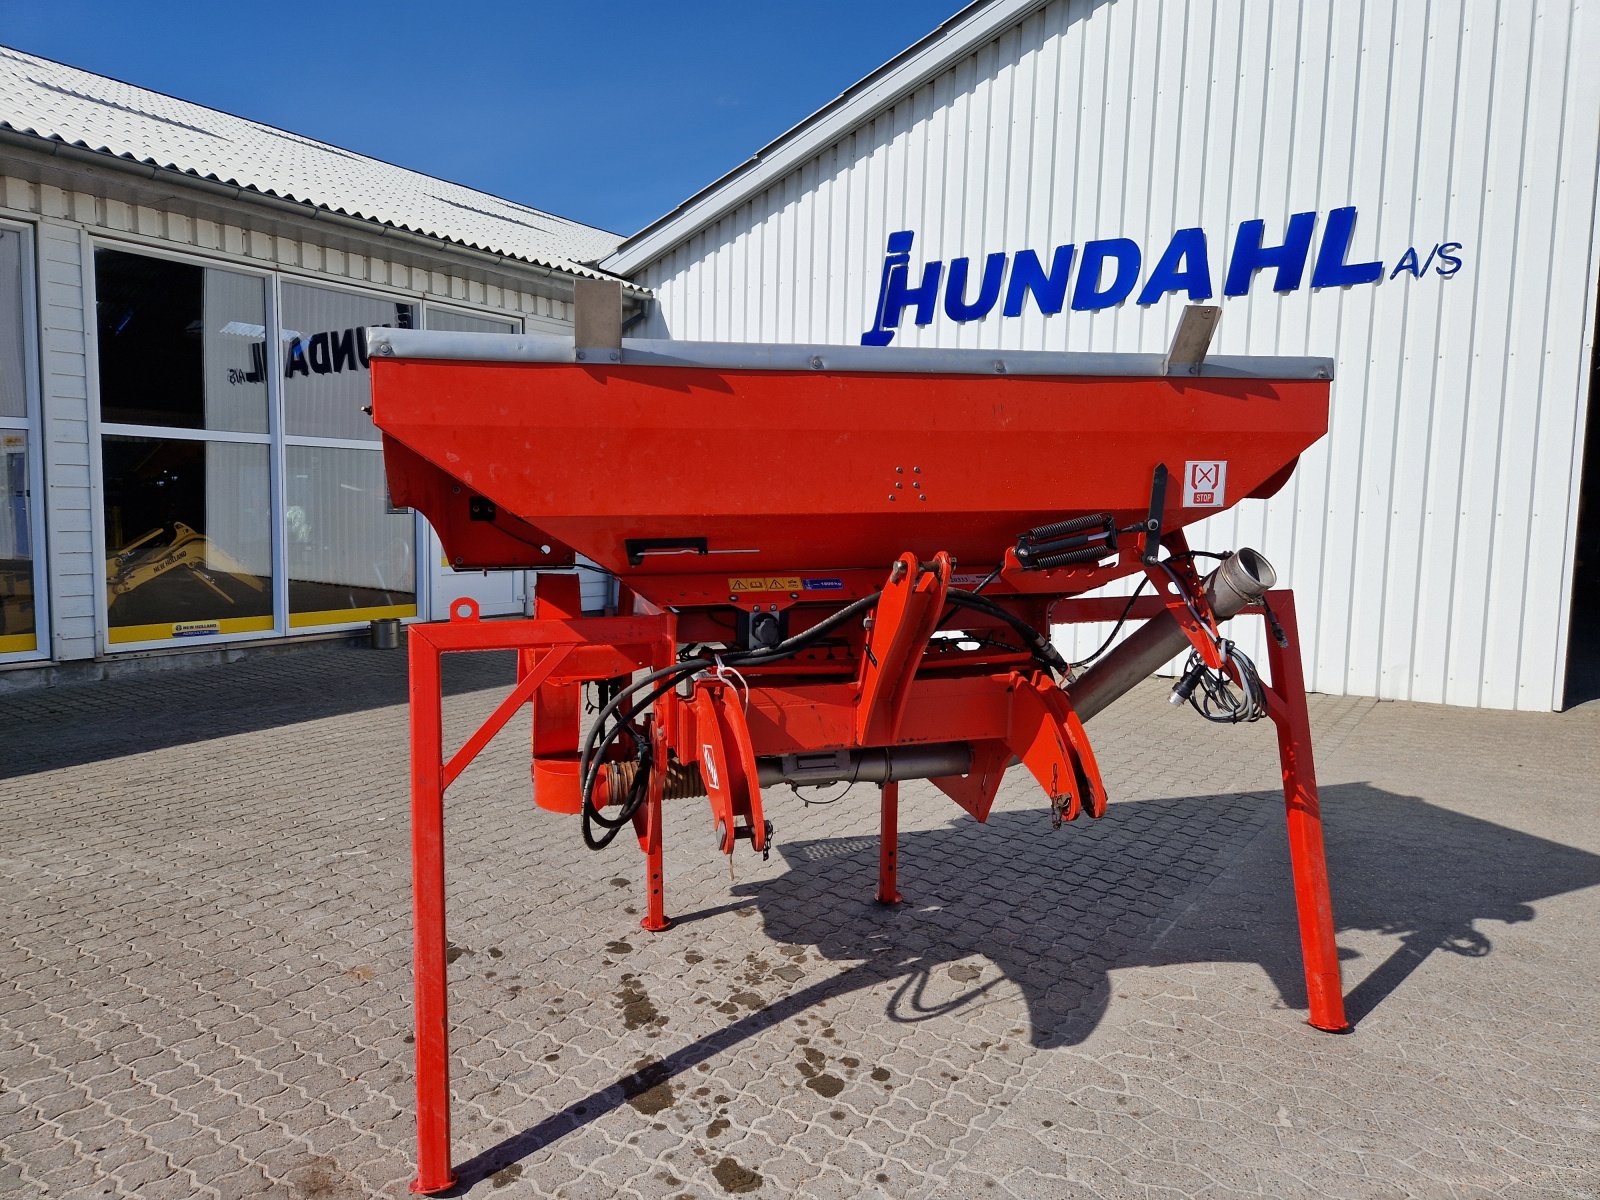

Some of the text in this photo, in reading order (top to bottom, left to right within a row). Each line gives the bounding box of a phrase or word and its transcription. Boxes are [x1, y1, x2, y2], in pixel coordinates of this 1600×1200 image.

[1390, 242, 1463, 280] A/S
[1196, 493, 1211, 502] STOP
[154, 550, 186, 573] NEW HOLLAND
